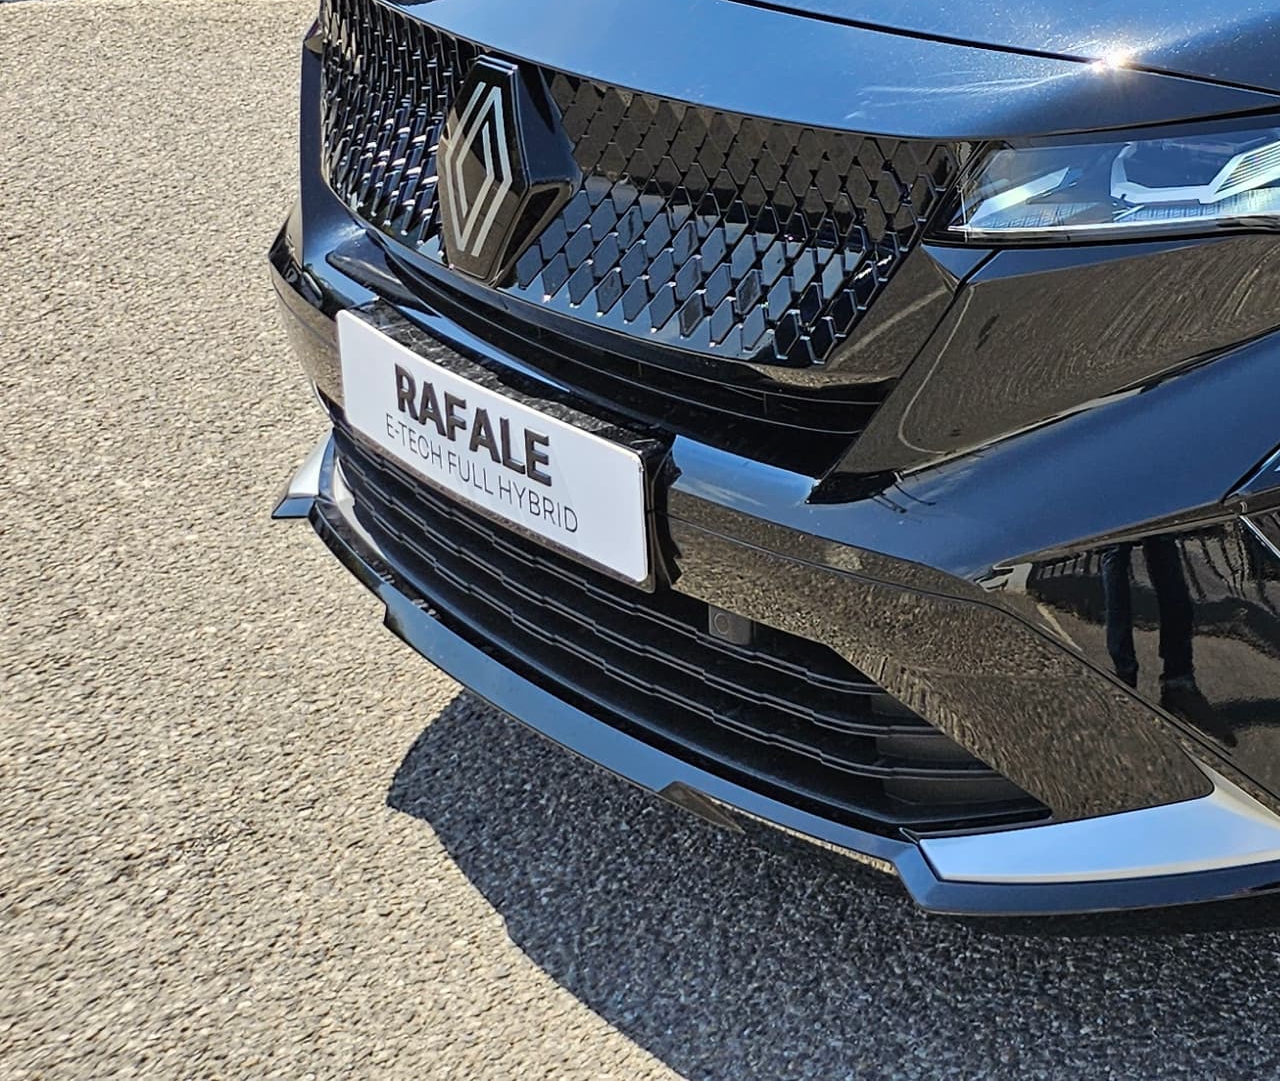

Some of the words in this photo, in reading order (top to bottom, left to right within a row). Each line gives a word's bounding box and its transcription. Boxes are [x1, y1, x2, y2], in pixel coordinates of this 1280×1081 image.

[386, 413, 443, 470] E-TECH
[448, 451, 494, 496] FULL
[498, 475, 579, 533] HYBRID
[394, 363, 552, 487] RAFALE
